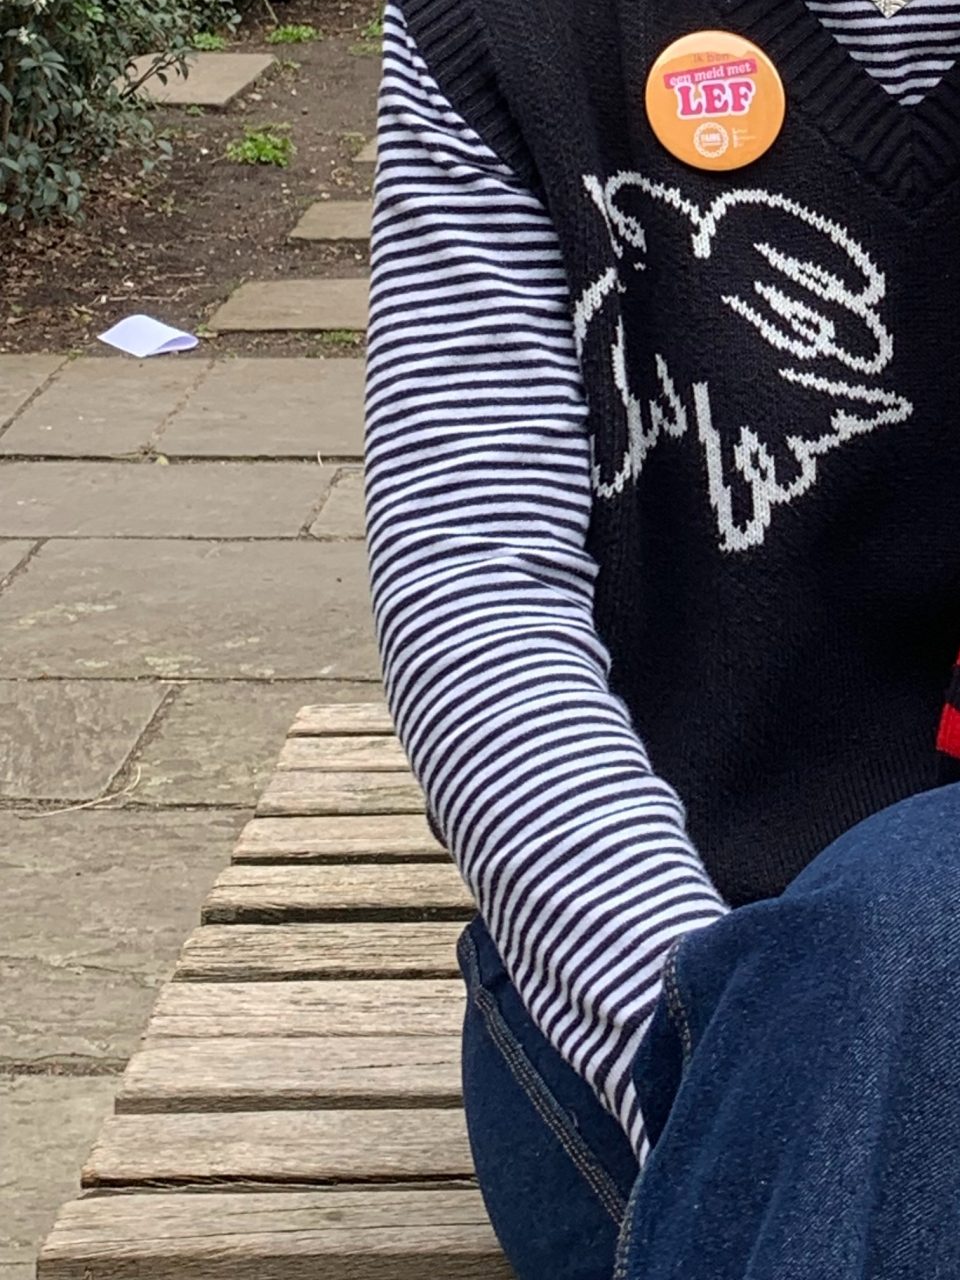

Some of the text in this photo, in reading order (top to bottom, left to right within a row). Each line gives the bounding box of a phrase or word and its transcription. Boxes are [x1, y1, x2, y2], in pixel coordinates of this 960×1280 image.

[669, 61, 752, 87] een meid met
[677, 80, 754, 116] LEF
